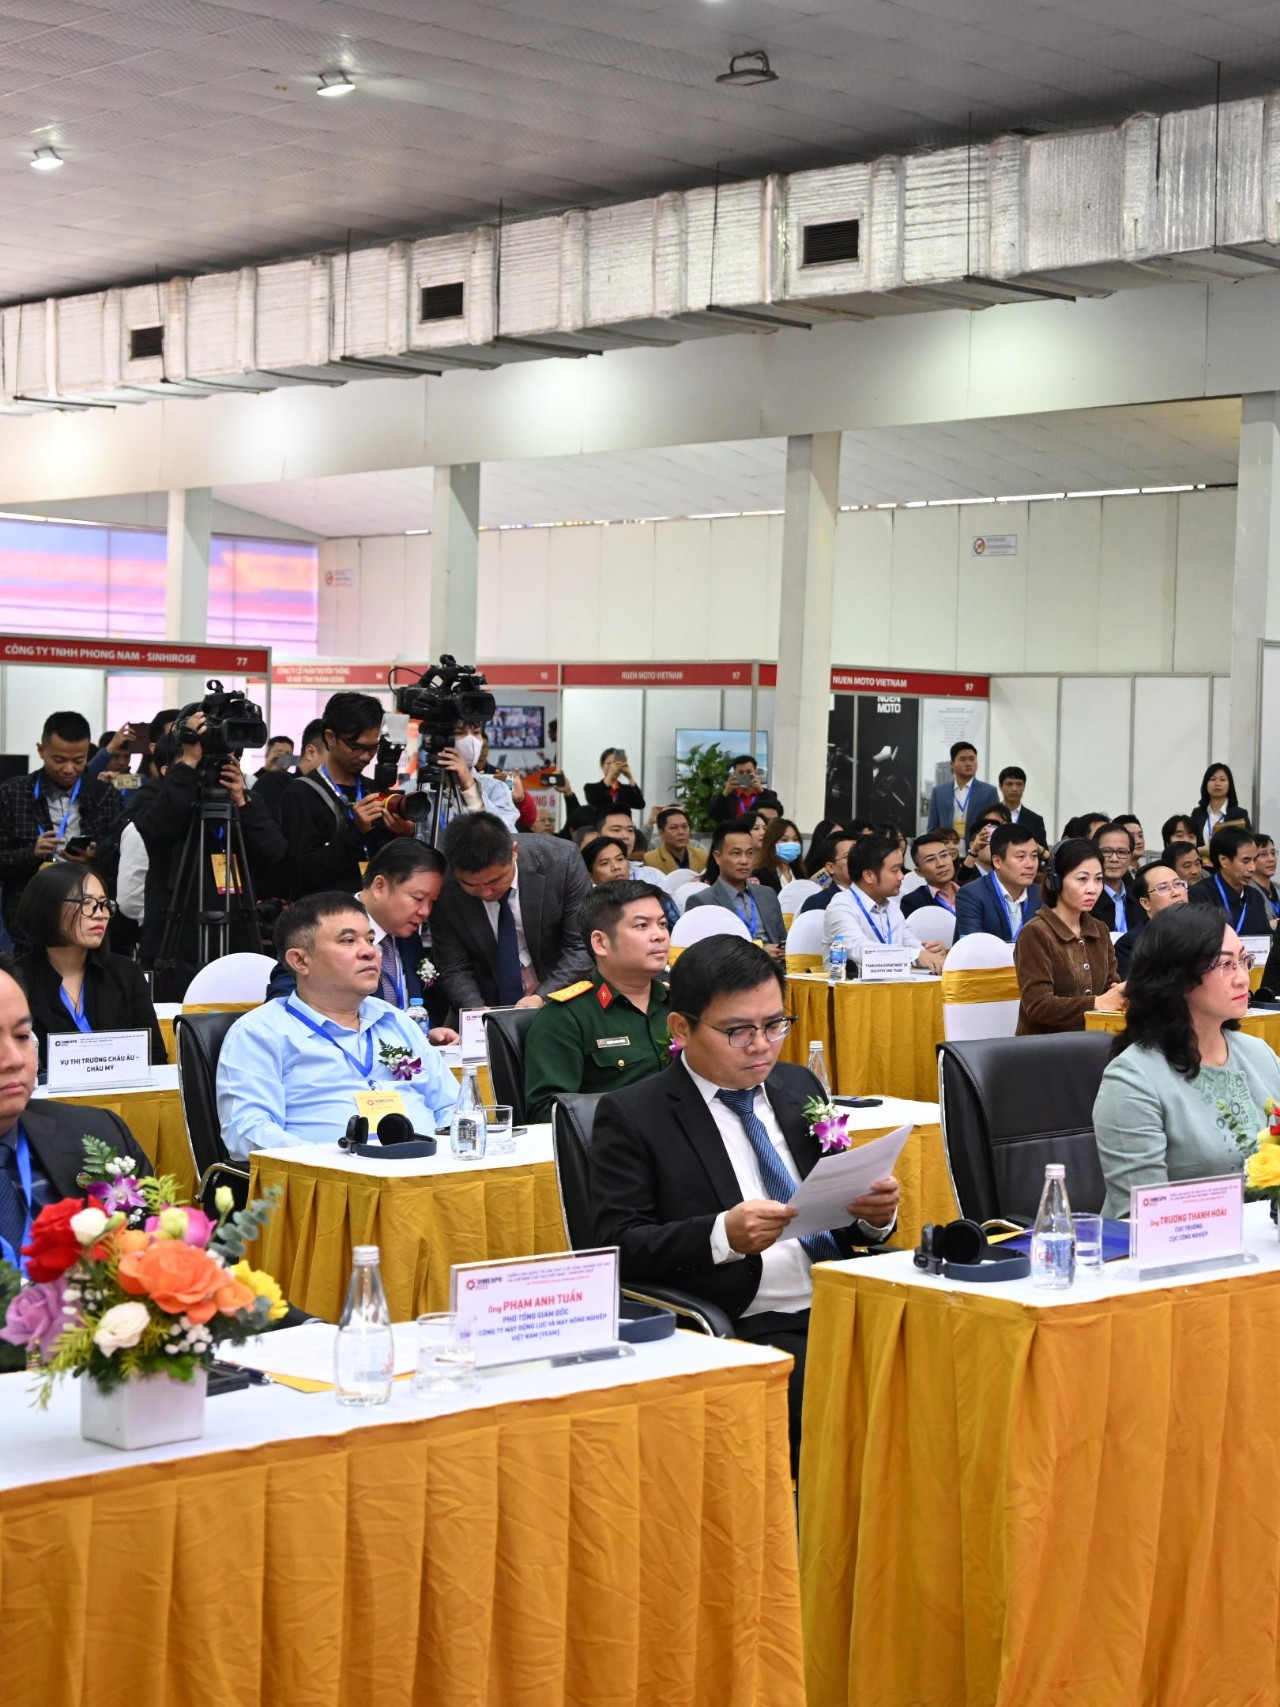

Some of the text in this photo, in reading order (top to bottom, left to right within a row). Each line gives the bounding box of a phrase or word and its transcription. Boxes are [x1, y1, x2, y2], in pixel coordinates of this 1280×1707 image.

[5, 644, 34, 656] CÔNG
[36, 645, 48, 656] TY
[50, 646, 78, 658] TNHH
[80, 648, 115, 660] PHONG
[117, 650, 140, 661] NAM
[147, 651, 196, 664] SINHIROSE
[236, 657, 248, 666] 77
[638, 671, 656, 680] MOTO
[656, 671, 683, 680] VIETNAM
[732, 672, 740, 680] 97
[832, 676, 908, 688] NUEN MOTO VIETNAM
[965, 683, 974, 691] 97
[877, 704, 902, 714] MOTO
[1188, 1212, 1210, 1221] THANH
[503, 1300, 532, 1314] PHẠM
[534, 1295, 555, 1306] ANH
[556, 1288, 583, 1304] TUẤN
[525, 1330, 538, 1340] NAM
